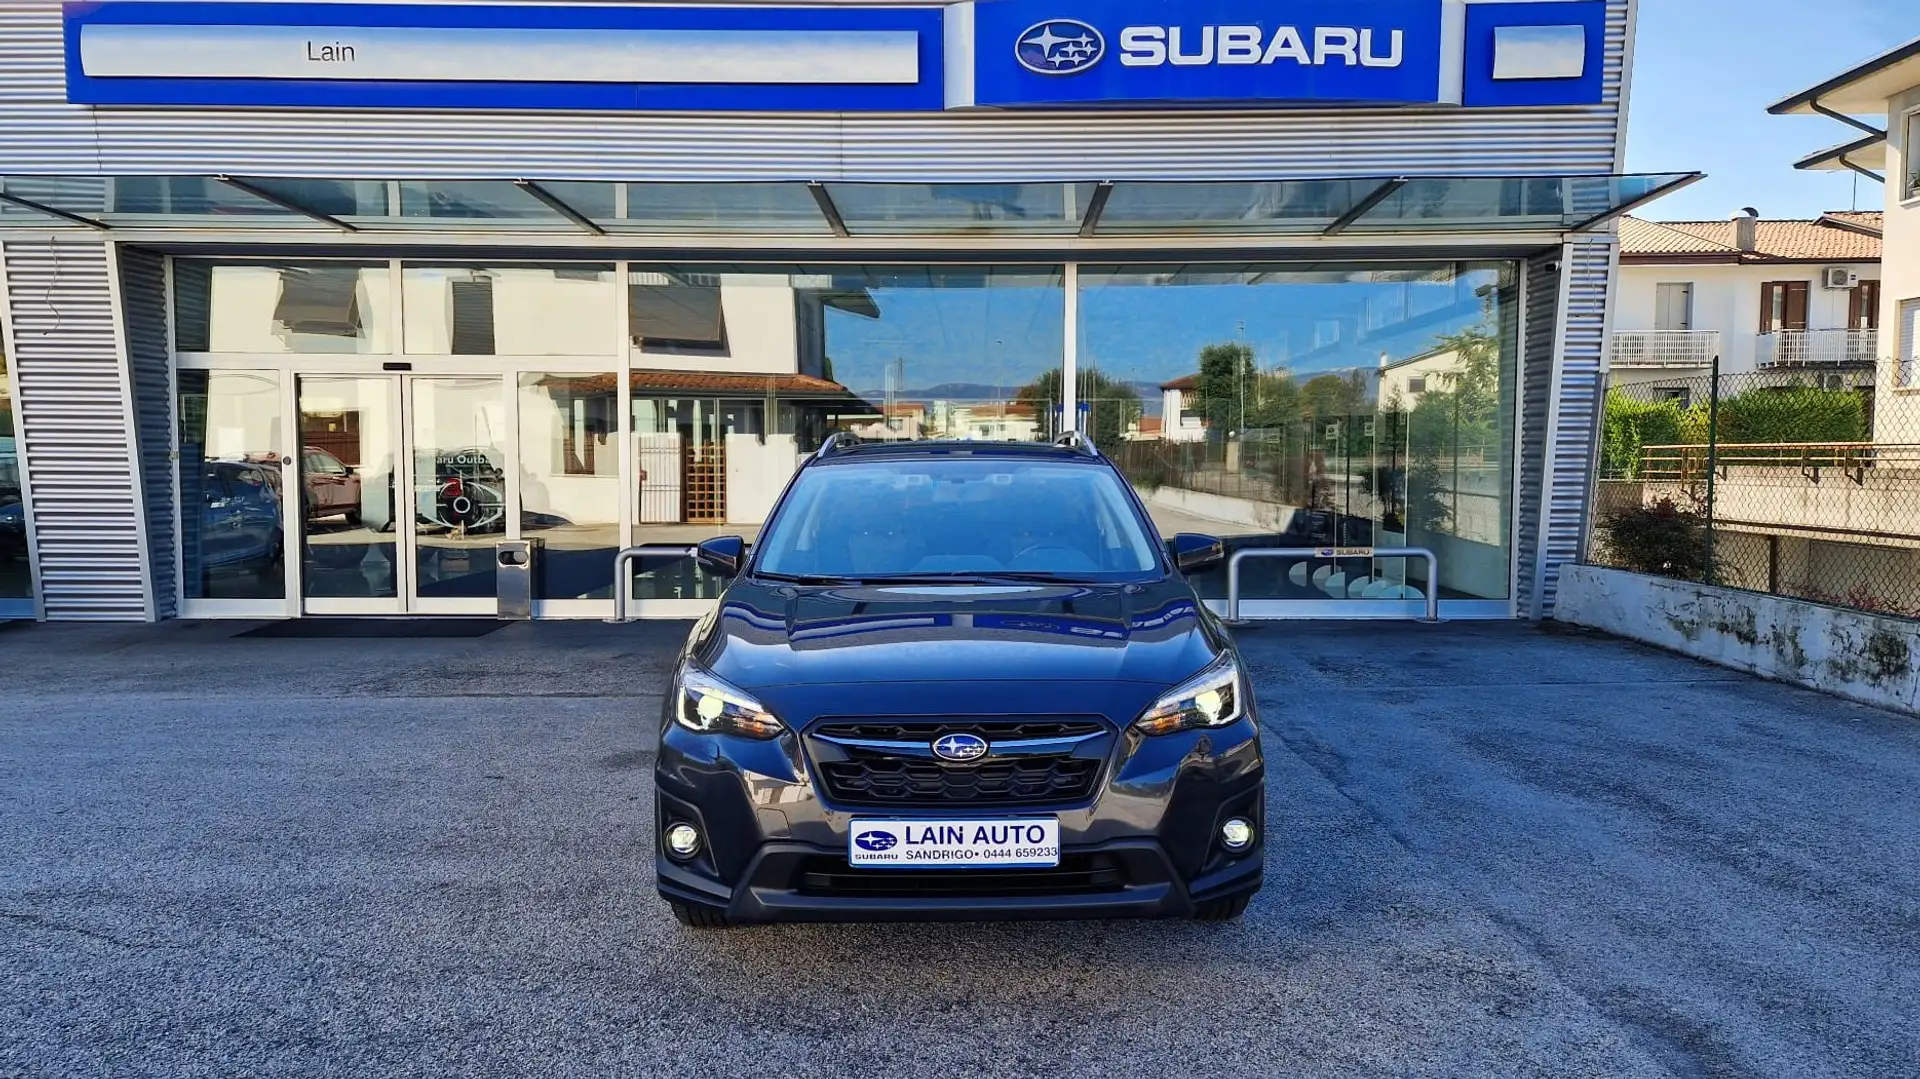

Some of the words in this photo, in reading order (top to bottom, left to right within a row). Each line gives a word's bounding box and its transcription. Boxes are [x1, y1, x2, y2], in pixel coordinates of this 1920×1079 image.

[307, 40, 355, 62] Lain
[1120, 25, 1403, 67] SUBARU
[905, 825, 964, 845] LAIN
[972, 824, 1046, 845] AUTO
[983, 848, 1012, 859] 0444
[1015, 846, 1058, 858] 659233
